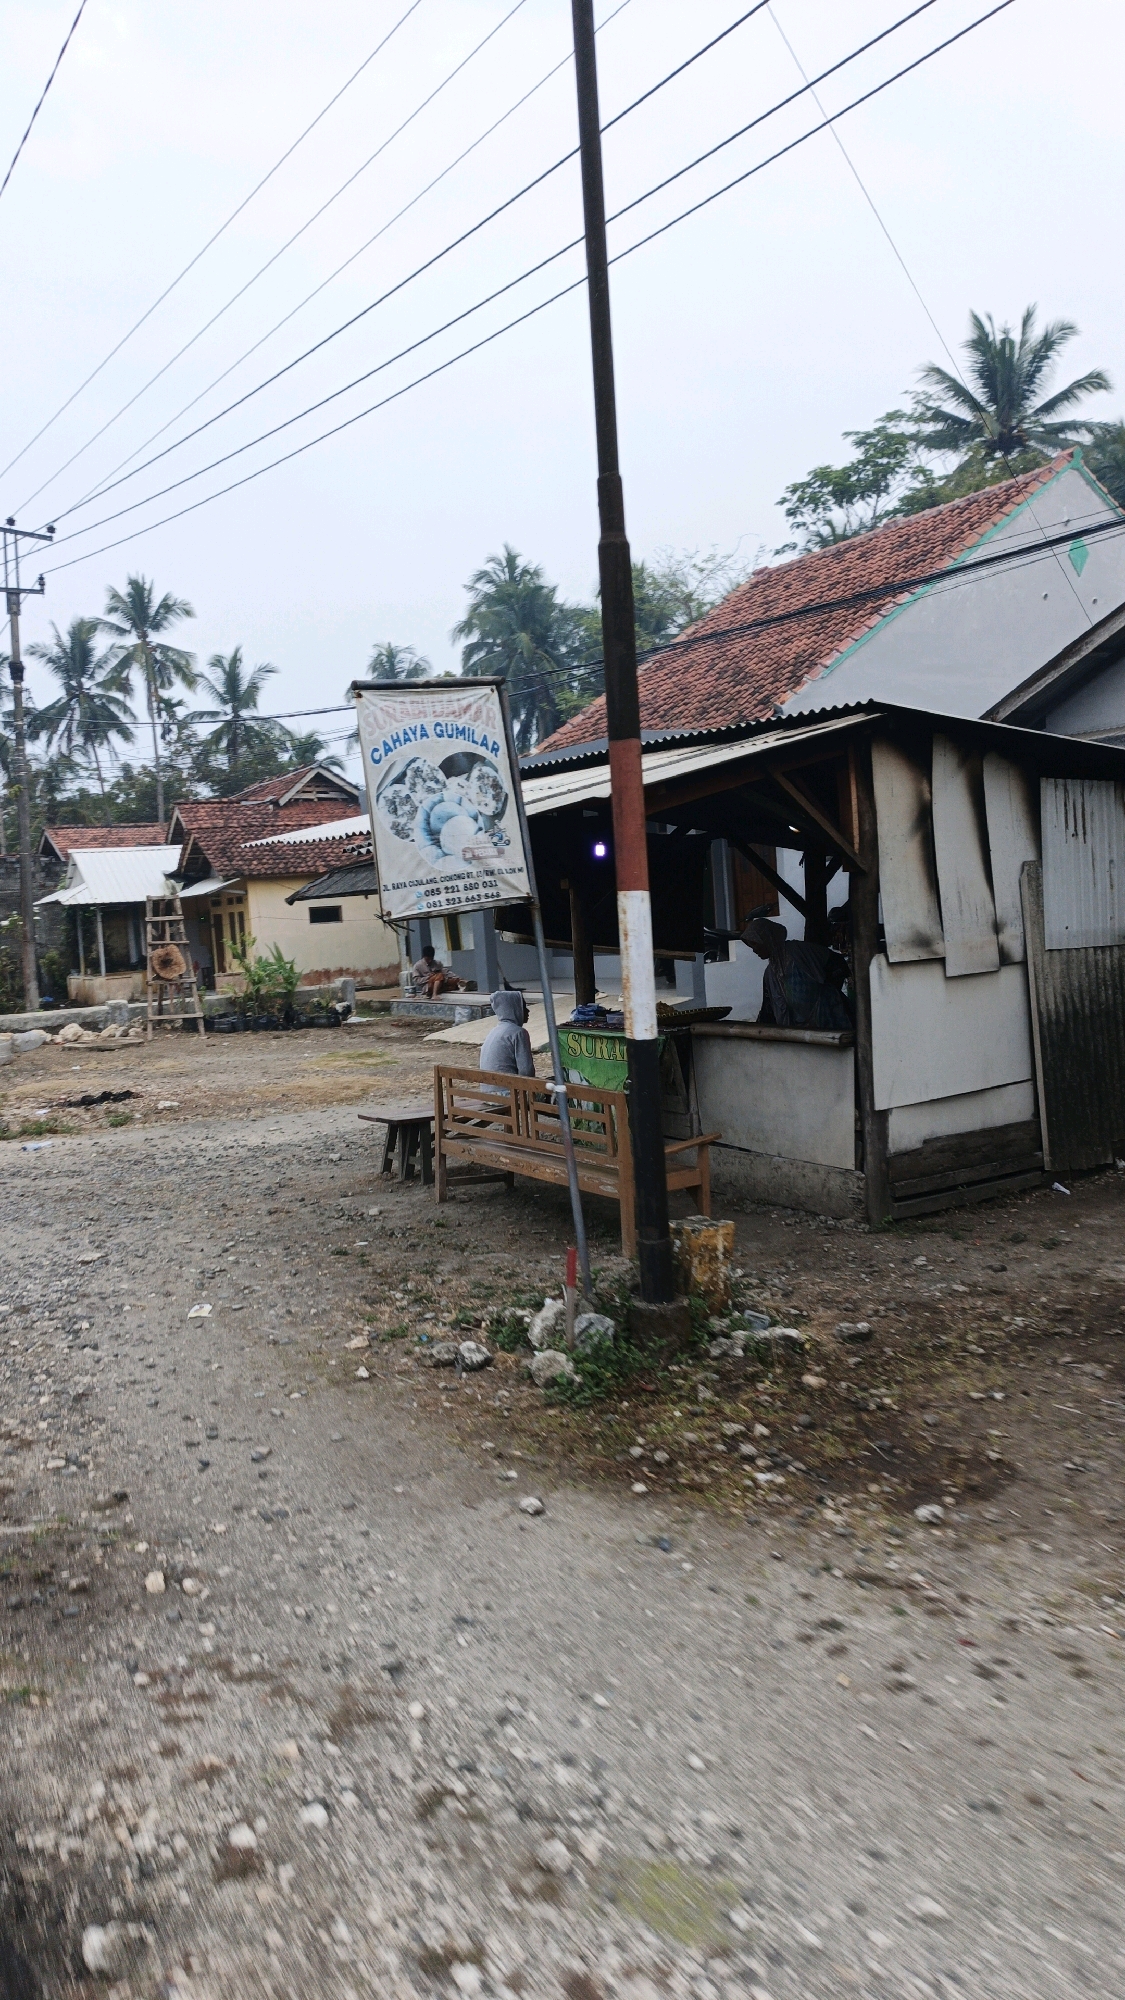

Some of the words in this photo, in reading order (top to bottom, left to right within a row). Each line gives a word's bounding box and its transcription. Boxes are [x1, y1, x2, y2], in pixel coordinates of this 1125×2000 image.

[370, 723, 430, 765] CAHAYA
[433, 721, 501, 759] GUMILAR
[391, 881, 408, 890] RAYA
